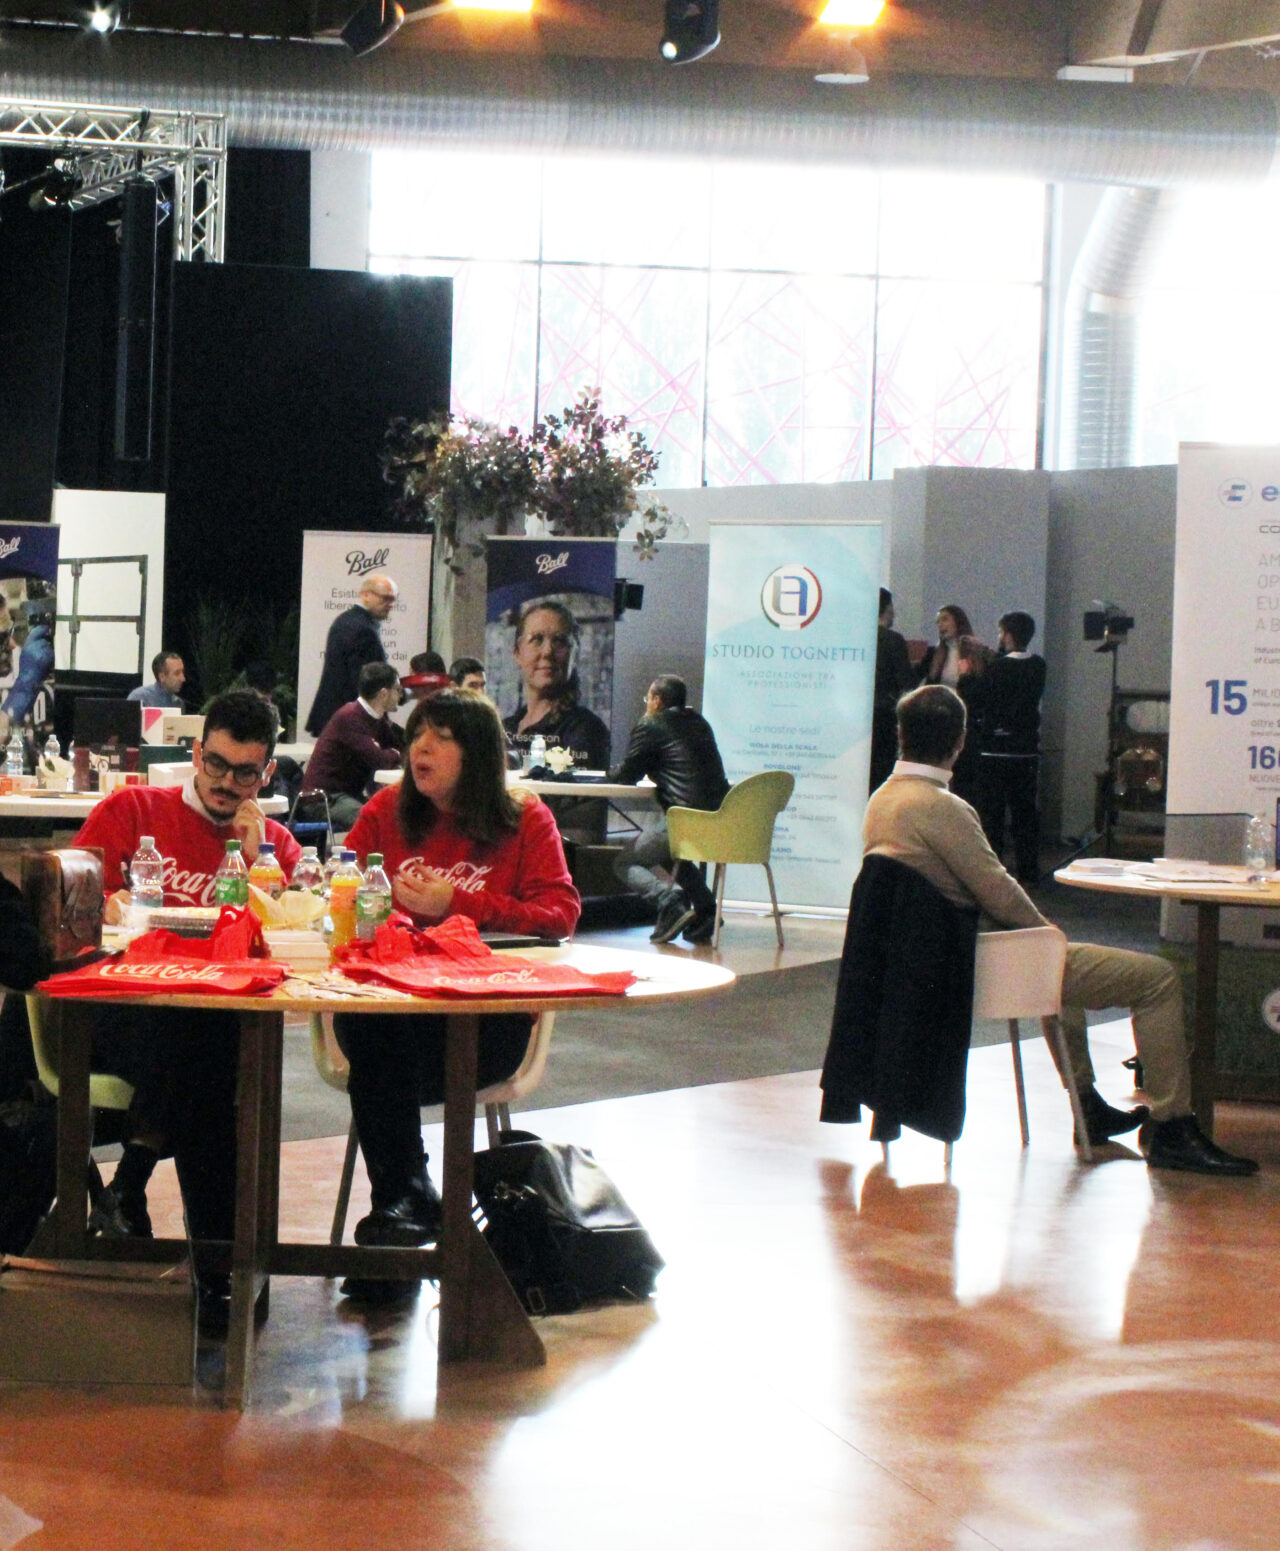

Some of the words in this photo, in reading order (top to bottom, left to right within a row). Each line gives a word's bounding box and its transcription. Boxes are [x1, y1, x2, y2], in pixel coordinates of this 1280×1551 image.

[345, 548, 390, 576] Ball
[535, 552, 569, 574] Ball
[712, 644, 775, 660] STUDIO
[781, 646, 866, 662] TOGNETTI
[1205, 680, 1248, 715] 15
[1247, 745, 1280, 769] 16
